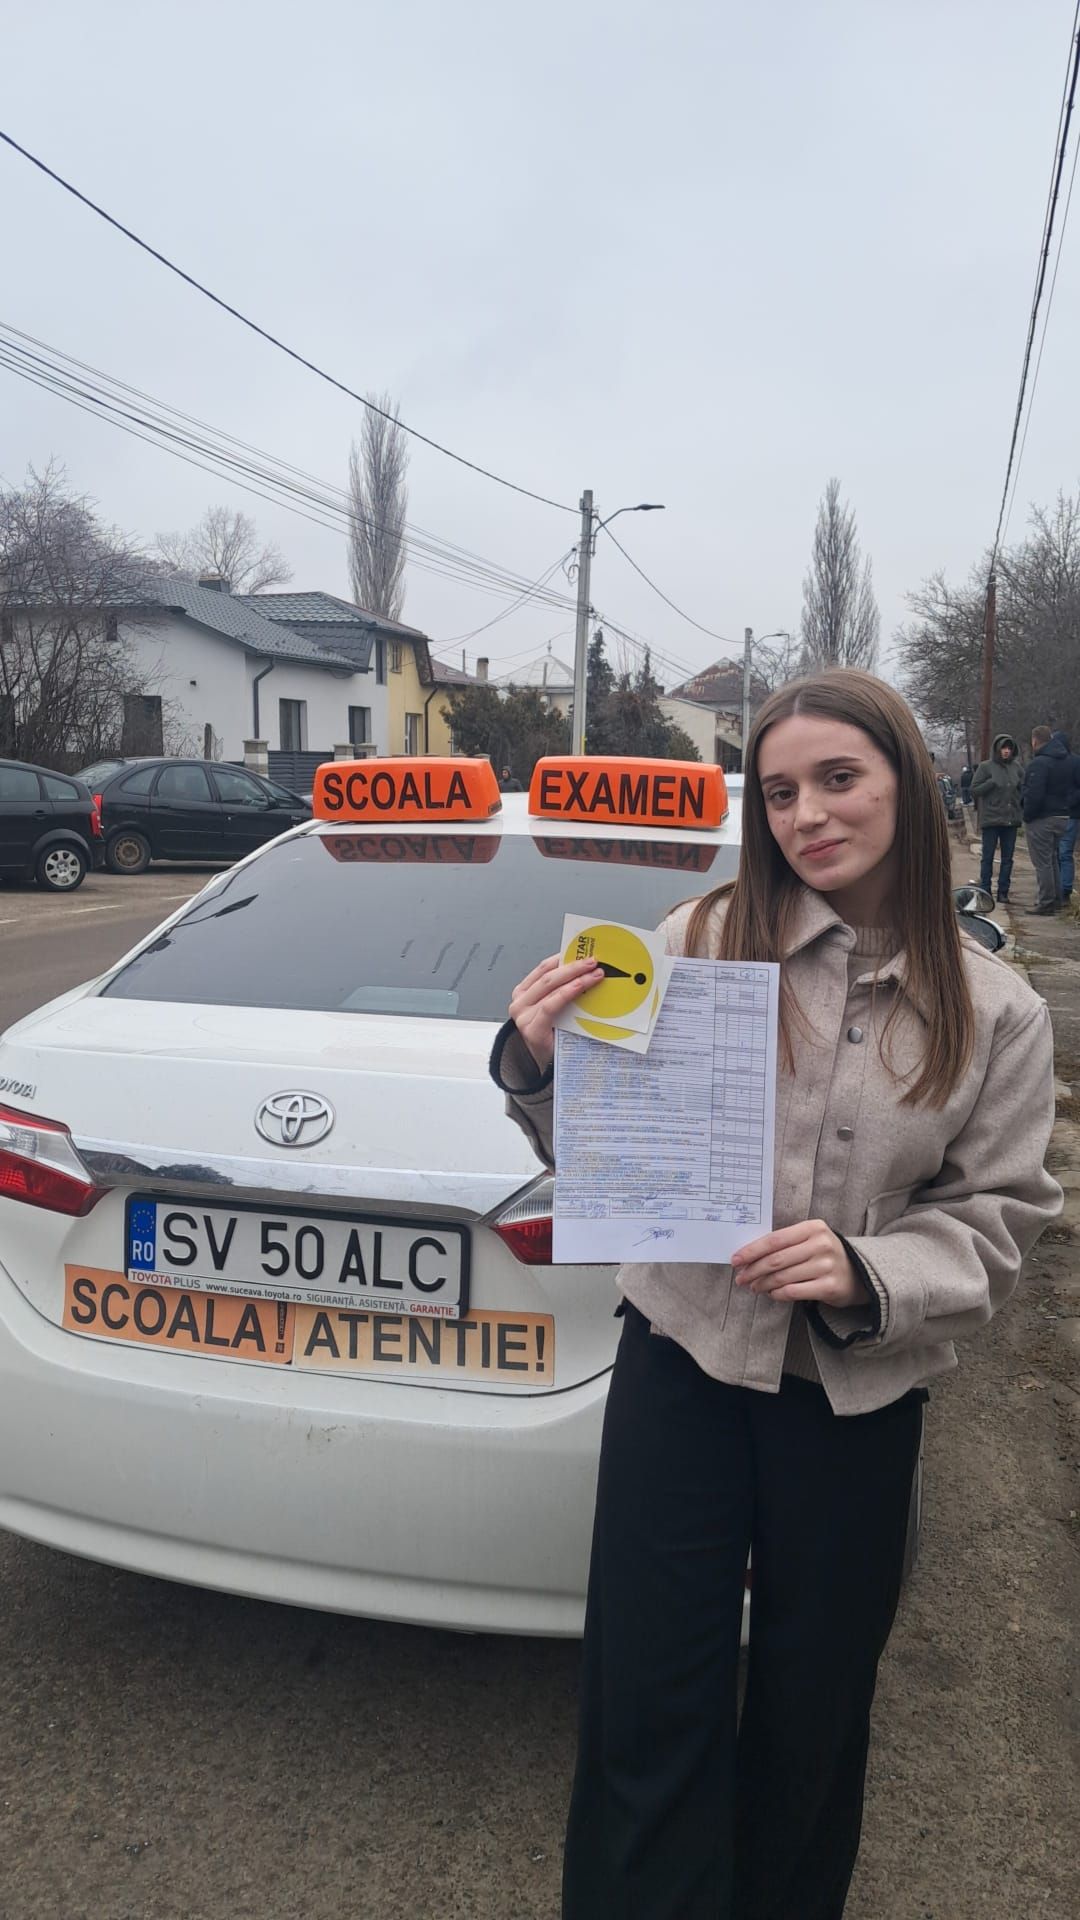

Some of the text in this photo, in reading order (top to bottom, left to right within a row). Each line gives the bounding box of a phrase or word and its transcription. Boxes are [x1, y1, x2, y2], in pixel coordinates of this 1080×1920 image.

[323, 771, 472, 811] SCOALA
[540, 769, 705, 819] EXAMEN
[0, 1076, 37, 1100] OYOTA
[132, 1239, 154, 1262] RO
[162, 1211, 448, 1293] SV 50 ALC
[131, 1270, 173, 1286] TOYOTA
[173, 1275, 201, 1290] PLUS
[205, 1281, 302, 1302] www.suceava.toyota.ro
[303, 1311, 546, 1373] ATENTIE!
